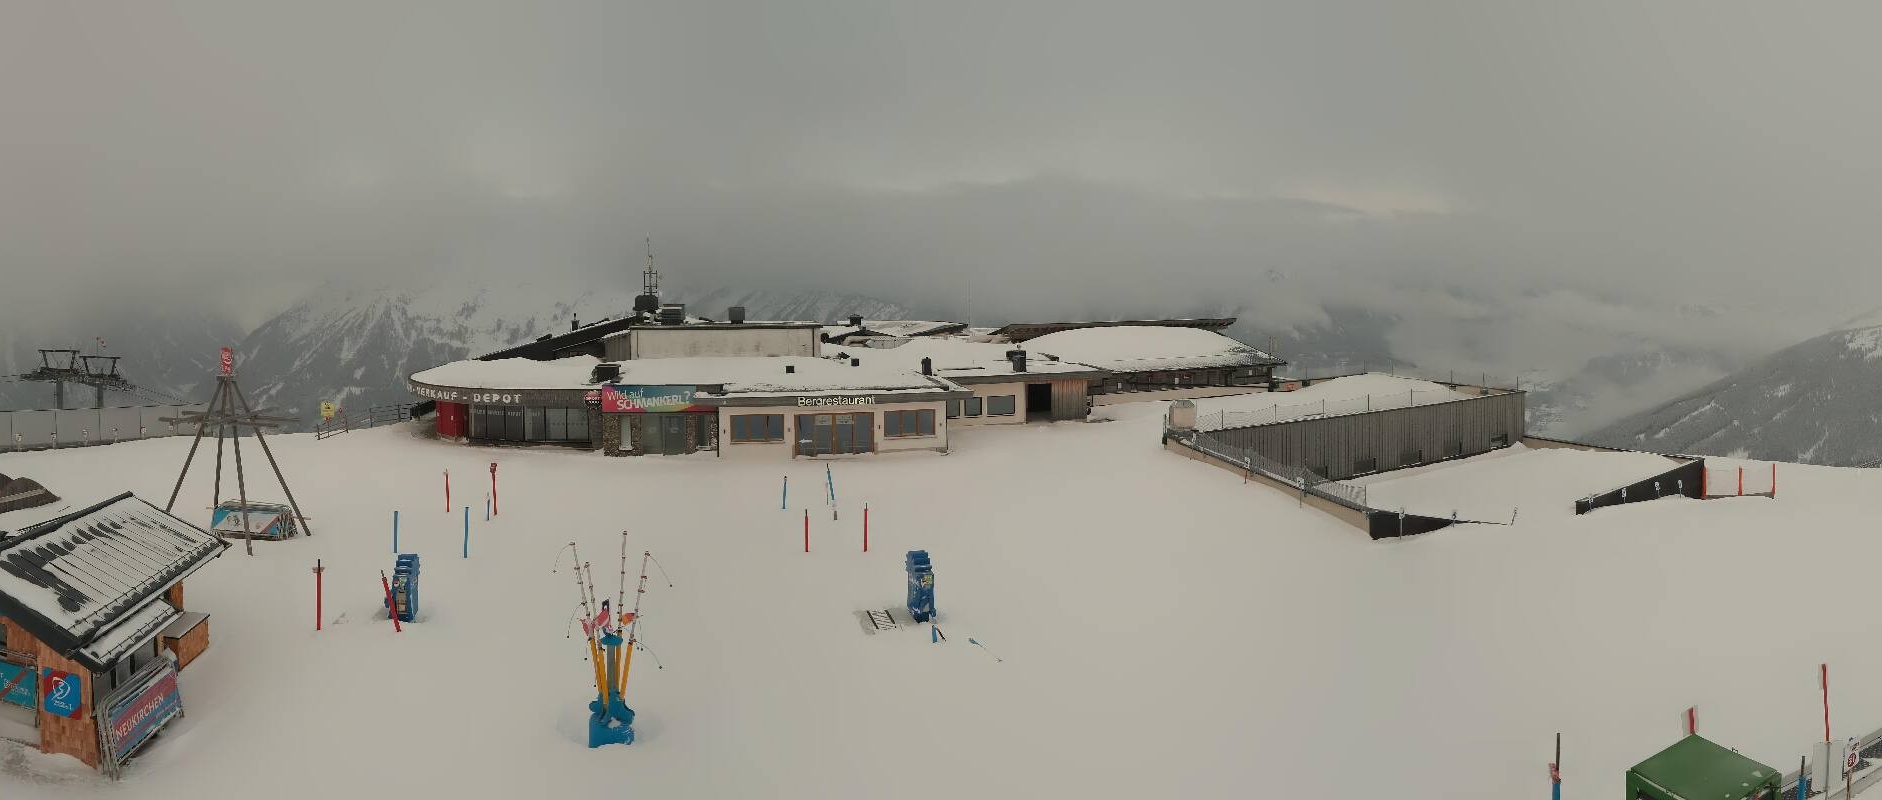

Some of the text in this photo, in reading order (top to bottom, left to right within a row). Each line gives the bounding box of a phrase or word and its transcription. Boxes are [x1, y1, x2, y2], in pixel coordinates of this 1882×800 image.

[416, 386, 457, 401] VERKAUF
[473, 393, 522, 404] DEPOT
[607, 387, 644, 401] Wild auf
[616, 390, 690, 410] SCHMANKERL?
[797, 395, 876, 408] Bergrestaurant
[115, 692, 164, 741] NEUKIRCHEN
